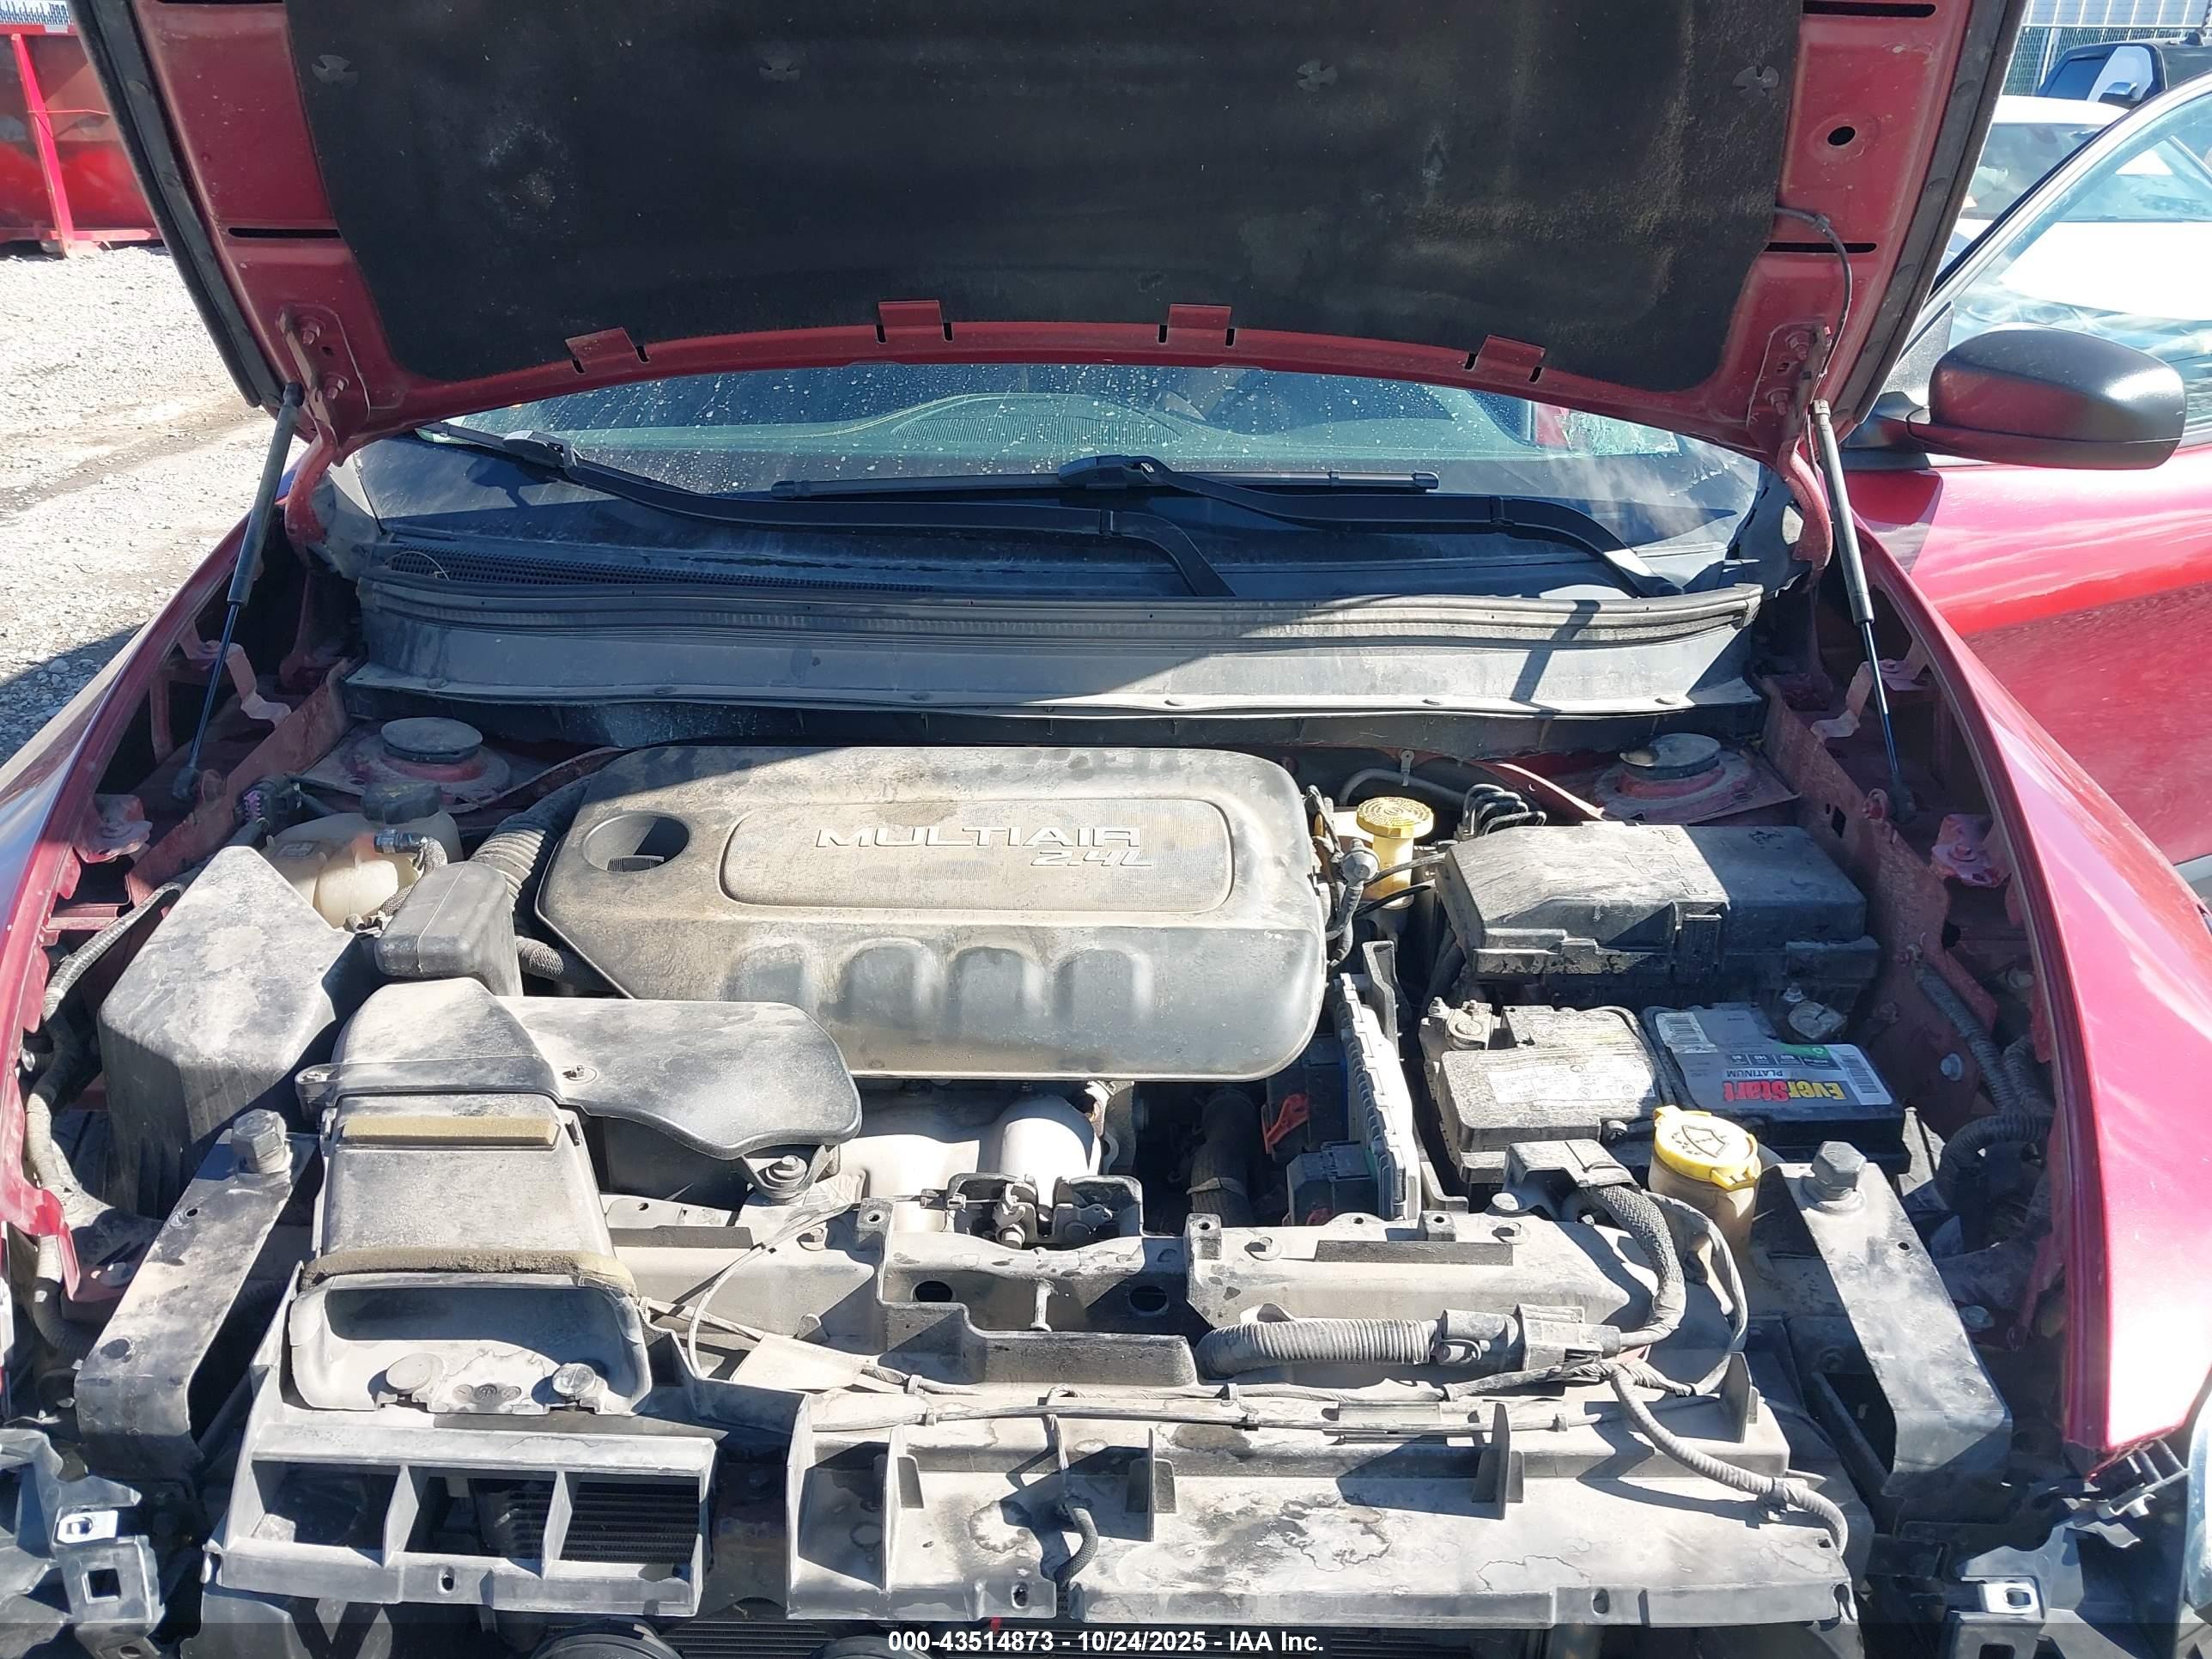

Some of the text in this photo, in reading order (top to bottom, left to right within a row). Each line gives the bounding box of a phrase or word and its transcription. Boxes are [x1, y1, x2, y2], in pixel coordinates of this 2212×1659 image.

[816, 827, 1141, 848] MULTIAIR
[1030, 849, 1152, 868] 2.4L
[1723, 1080, 1847, 1102] EverStart
